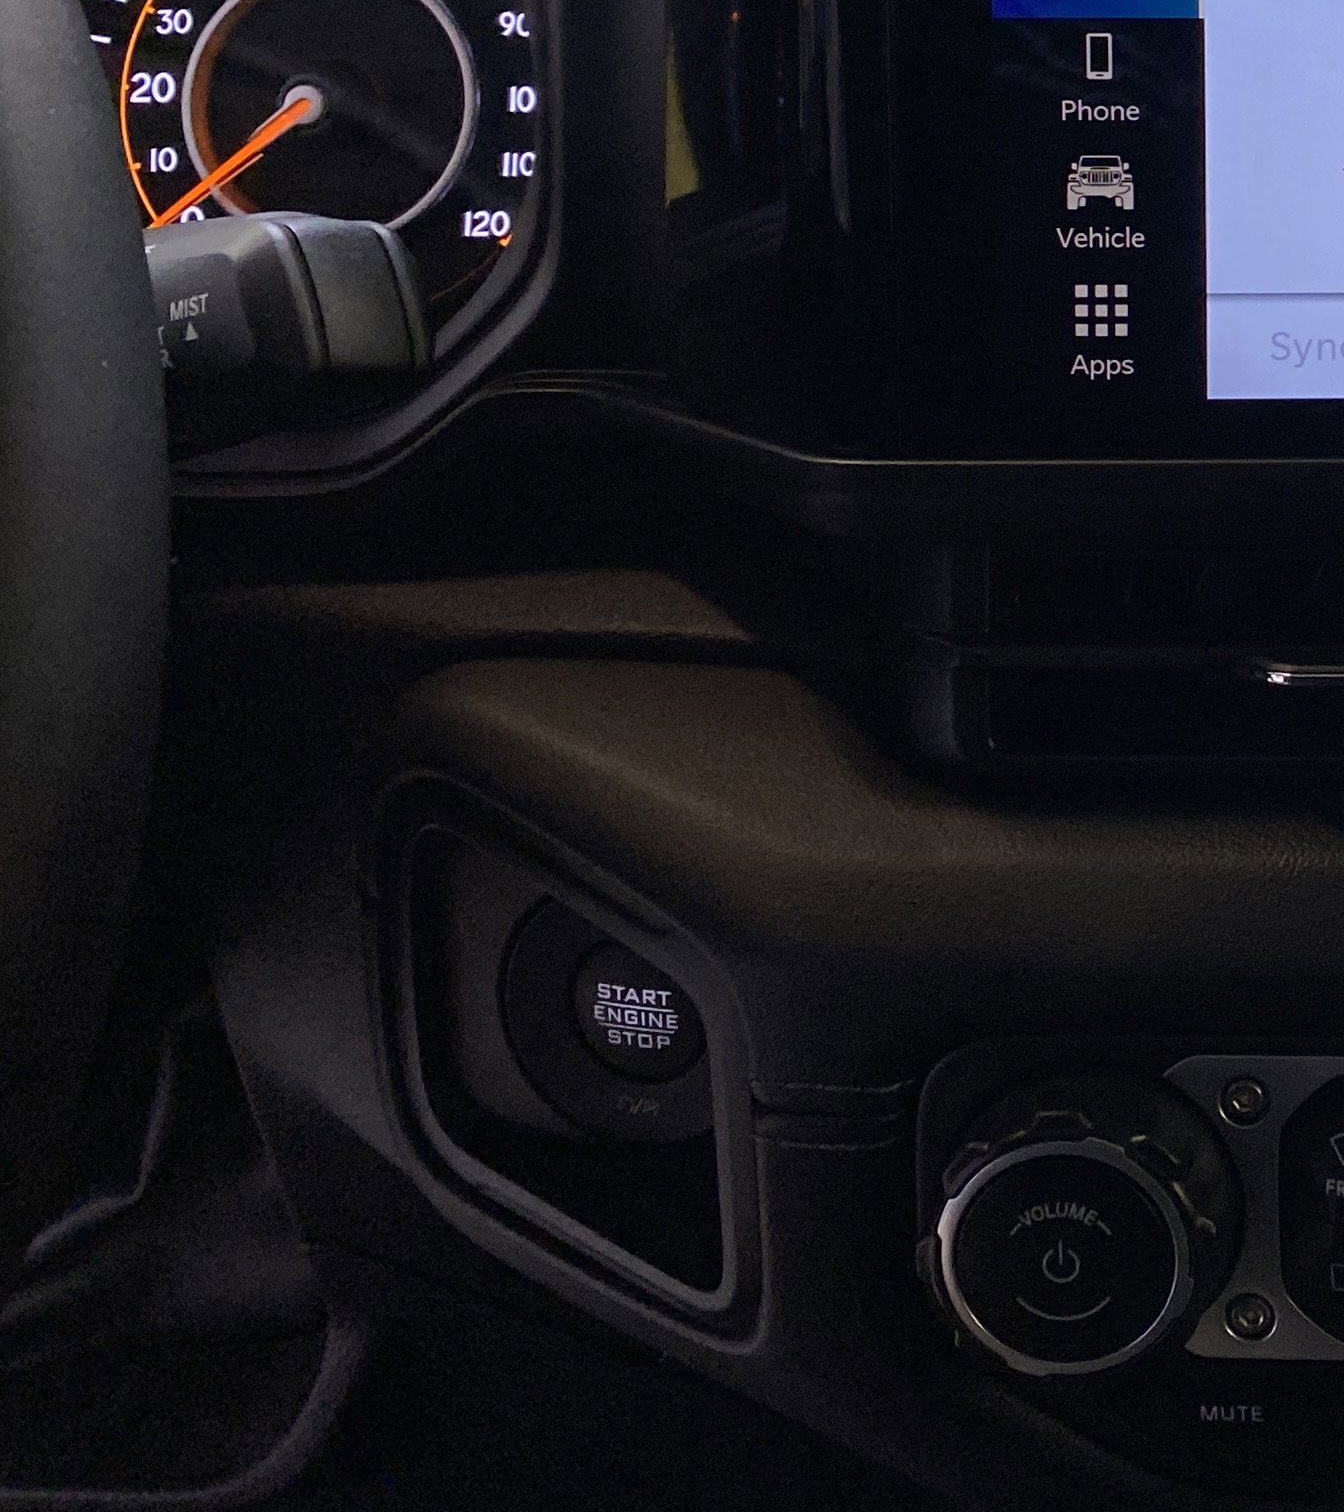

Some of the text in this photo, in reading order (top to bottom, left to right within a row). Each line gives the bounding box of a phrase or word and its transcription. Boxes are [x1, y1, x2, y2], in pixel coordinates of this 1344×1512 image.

[156, 8, 194, 35] 30
[130, 72, 176, 103] 20
[1061, 101, 1141, 123] Phone
[149, 148, 178, 172] 10
[463, 211, 511, 238] 120
[1056, 227, 1146, 250] Vehicle
[170, 292, 209, 322] MIST
[1071, 355, 1134, 379] Apps
[597, 983, 672, 1006] START
[594, 1004, 679, 1029] ENGINE
[607, 1029, 671, 1050] STOP
[1018, 1201, 1101, 1229] VOLUME
[1201, 1405, 1264, 1422] MUTE
